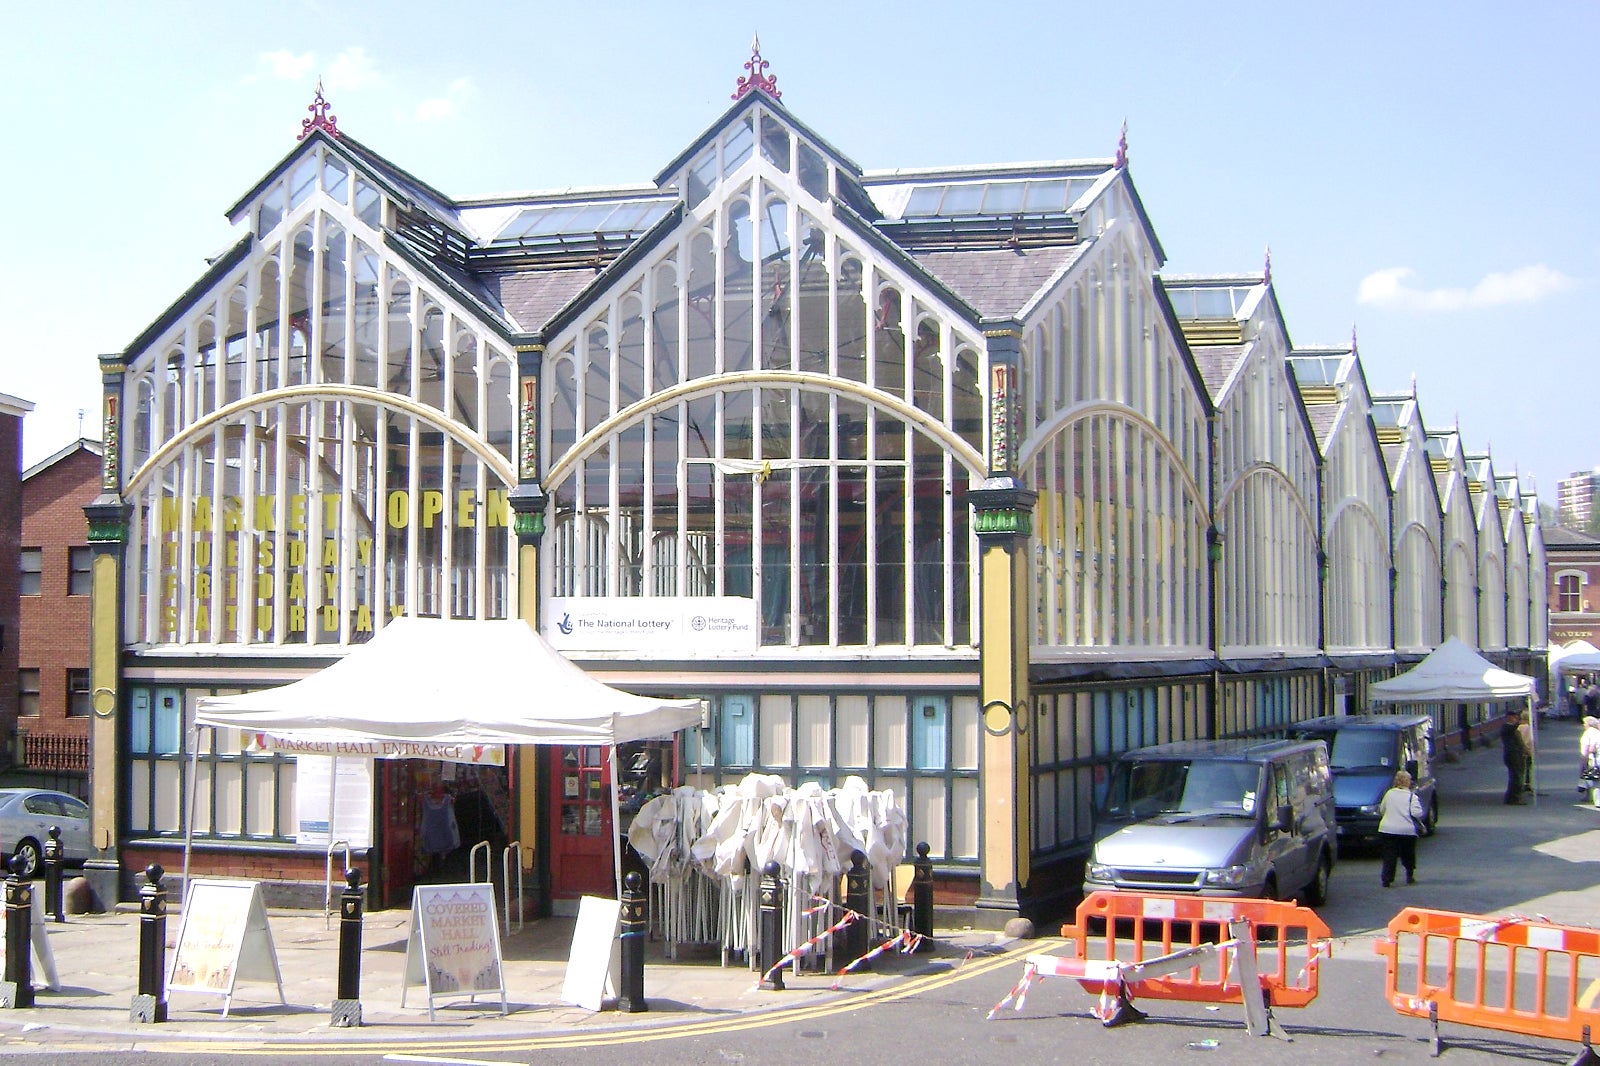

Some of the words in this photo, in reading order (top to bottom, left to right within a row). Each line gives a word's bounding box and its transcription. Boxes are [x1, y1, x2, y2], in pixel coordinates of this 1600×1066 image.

[162, 494, 341, 532] MARKET
[388, 490, 509, 528] OPEN
[167, 539, 373, 567] TUESDAY
[168, 573, 338, 600] FRIDAY
[578, 619, 595, 628] The
[597, 618, 635, 628] National
[638, 619, 671, 630] Lottery
[708, 616, 735, 626] Heritage
[708, 624, 731, 632] Lottery
[274, 738, 331, 752] MARKET
[336, 742, 379, 755] HALL
[383, 742, 463, 759] ENTRANCE
[427, 902, 487, 914] COVERED
[431, 914, 486, 928] MARKET
[441, 928, 479, 940] HALL
[430, 945, 450, 959] Still
